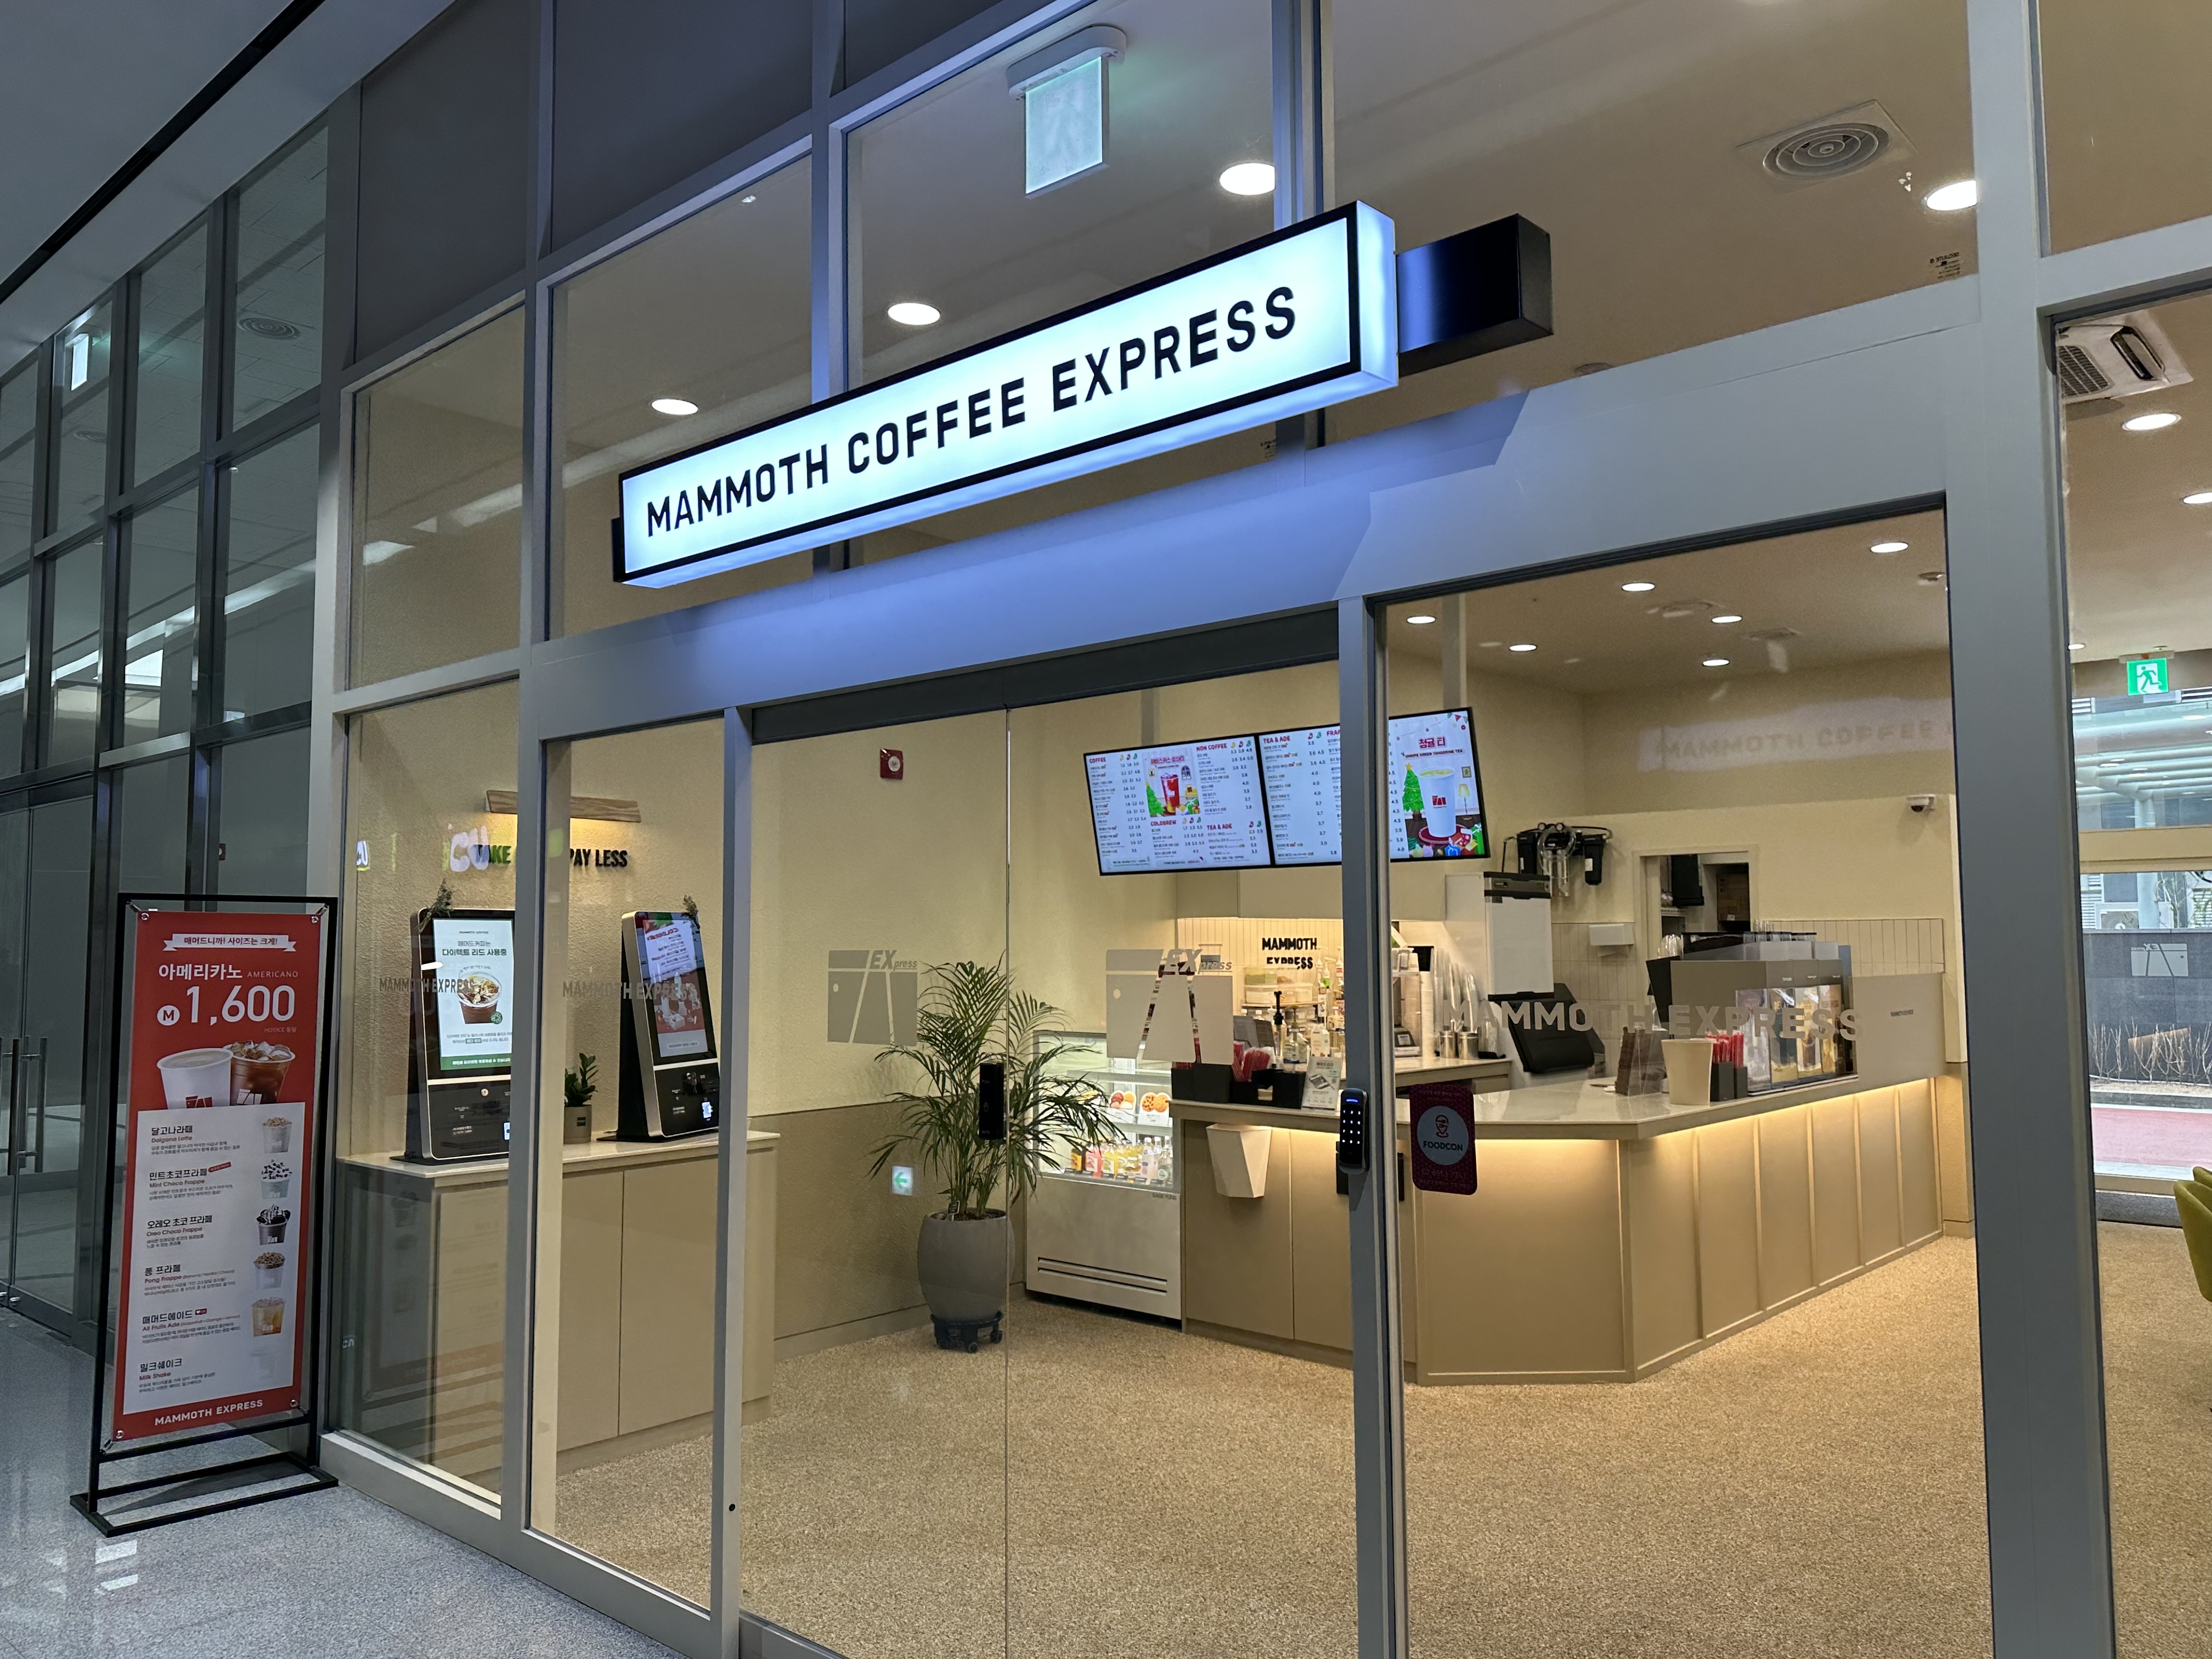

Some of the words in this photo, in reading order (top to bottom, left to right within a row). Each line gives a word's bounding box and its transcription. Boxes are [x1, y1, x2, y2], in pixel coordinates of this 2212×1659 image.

[646, 443, 827, 537] MAMMOTH
[848, 377, 1026, 475] COFFEE
[1052, 285, 1296, 412] EXPRESS
[1419, 738, 1435, 748] 청귤
[1437, 737, 1446, 746] 티
[450, 826, 488, 872] CU
[596, 850, 628, 867] LESS
[184, 937, 226, 945] 매머드니까!
[228, 937, 258, 945] 사이즈는
[1262, 938, 1317, 951] MAMMOTH
[159, 964, 242, 980] 아메리카노
[379, 978, 431, 993] MAMMOTH
[432, 978, 475, 994] EXPRESS
[562, 981, 632, 1000] MAMMOTH
[635, 981, 696, 1002] EXPRESS
[163, 1010, 174, 1020] M
[187, 985, 295, 1026] 1,600
[1447, 1001, 1651, 1032] MAMMOTH
[1669, 1005, 1864, 1041] EXPRESS
[151, 1125, 193, 1136] 달고나라떼
[1423, 1141, 1463, 1151] FOODCON
[150, 1169, 207, 1181] 민트초코프라페
[147, 1219, 171, 1229] 오레오
[172, 1217, 188, 1226] 초코
[189, 1215, 212, 1224] 프라페
[156, 1264, 180, 1274] 프라페
[143, 1310, 193, 1324] 매머드에이드
[140, 1358, 182, 1372] 밀크쉐이크
[155, 1408, 212, 1426] MAMMOTH
[216, 1400, 263, 1415] EXPRESS
